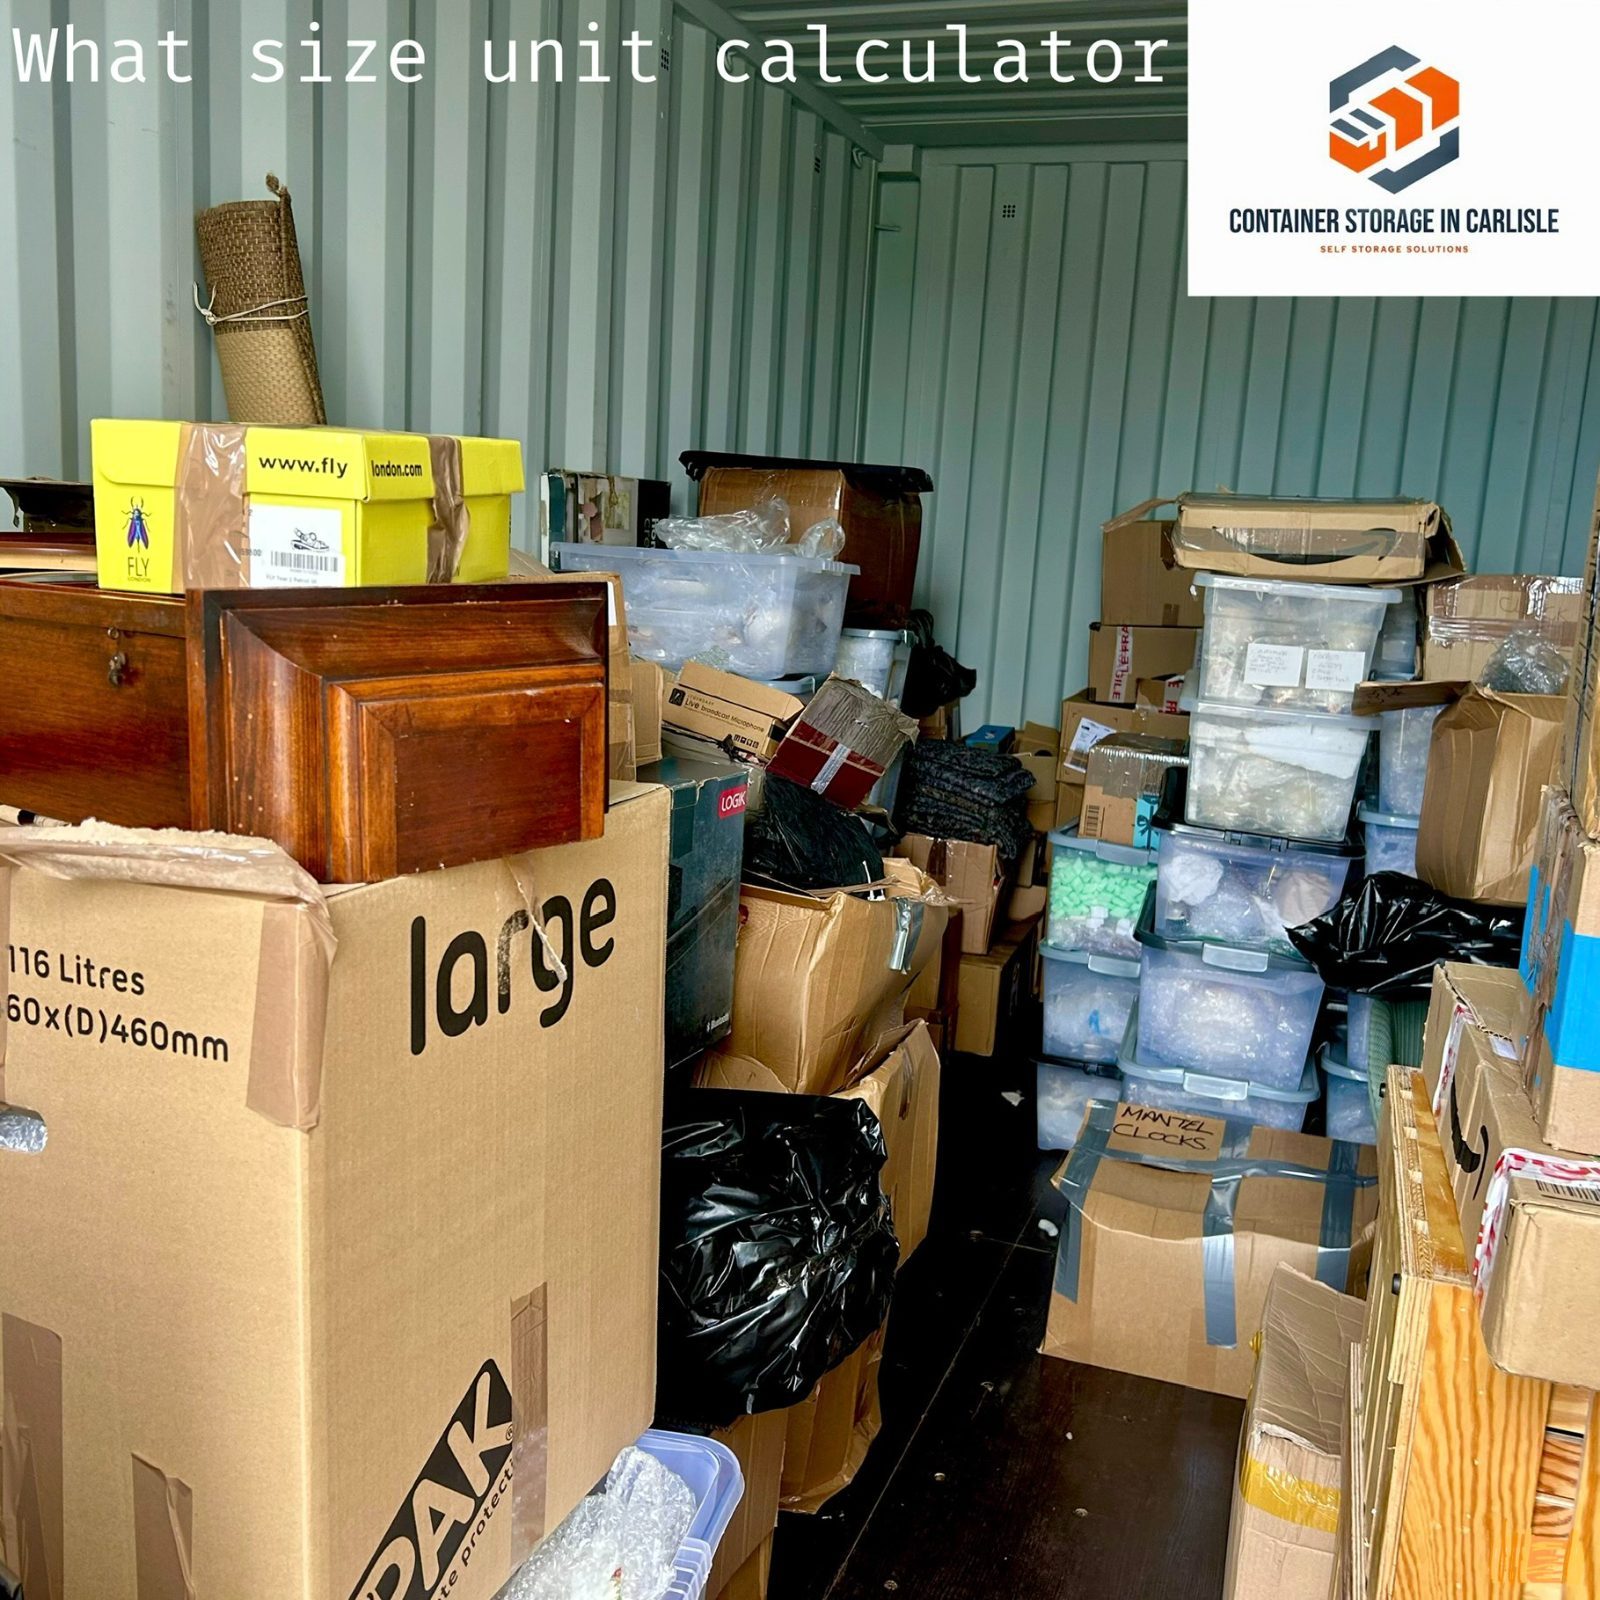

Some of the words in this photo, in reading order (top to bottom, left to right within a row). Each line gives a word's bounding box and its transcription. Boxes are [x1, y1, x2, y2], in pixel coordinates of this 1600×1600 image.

[258, 456, 348, 479] www.fly
[371, 459, 423, 478] london.com
[127, 556, 150, 577] FLY
[684, 697, 700, 710] Live
[9, 944, 50, 979] 116
[59, 952, 146, 996] Litres
[410, 877, 617, 1056] large
[1121, 1105, 1214, 1136] MANTEL
